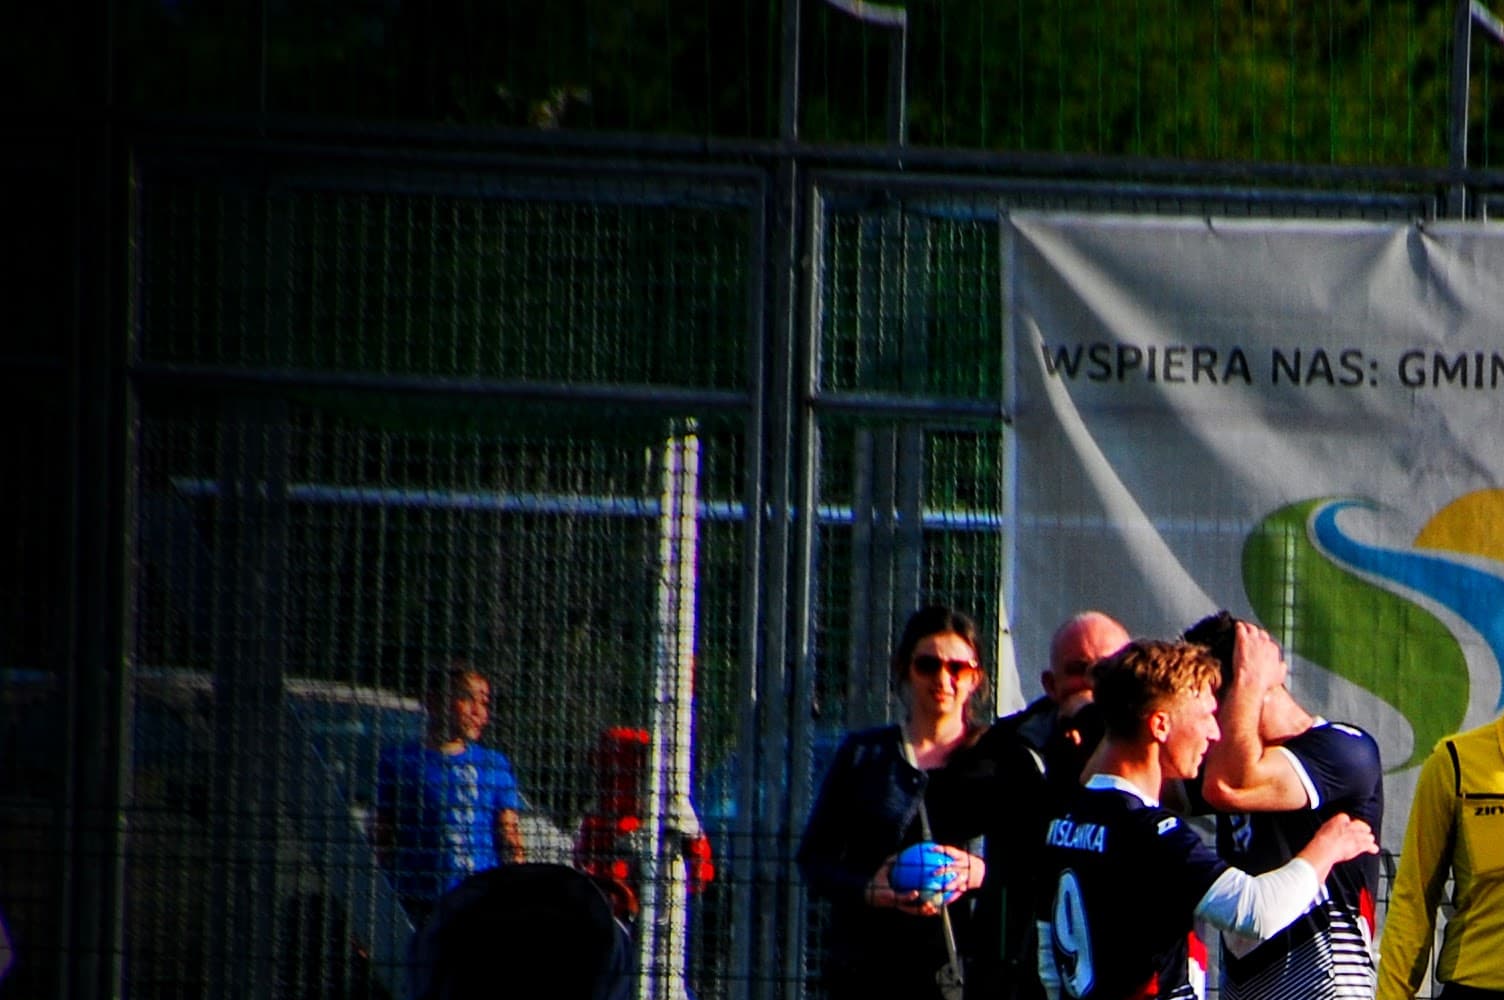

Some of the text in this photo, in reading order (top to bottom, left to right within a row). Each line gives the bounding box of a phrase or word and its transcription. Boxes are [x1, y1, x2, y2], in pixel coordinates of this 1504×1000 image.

[1041, 343, 1253, 386] WSPIERA
[1271, 347, 1378, 388] NAS:
[1052, 868, 1095, 1000] 9
